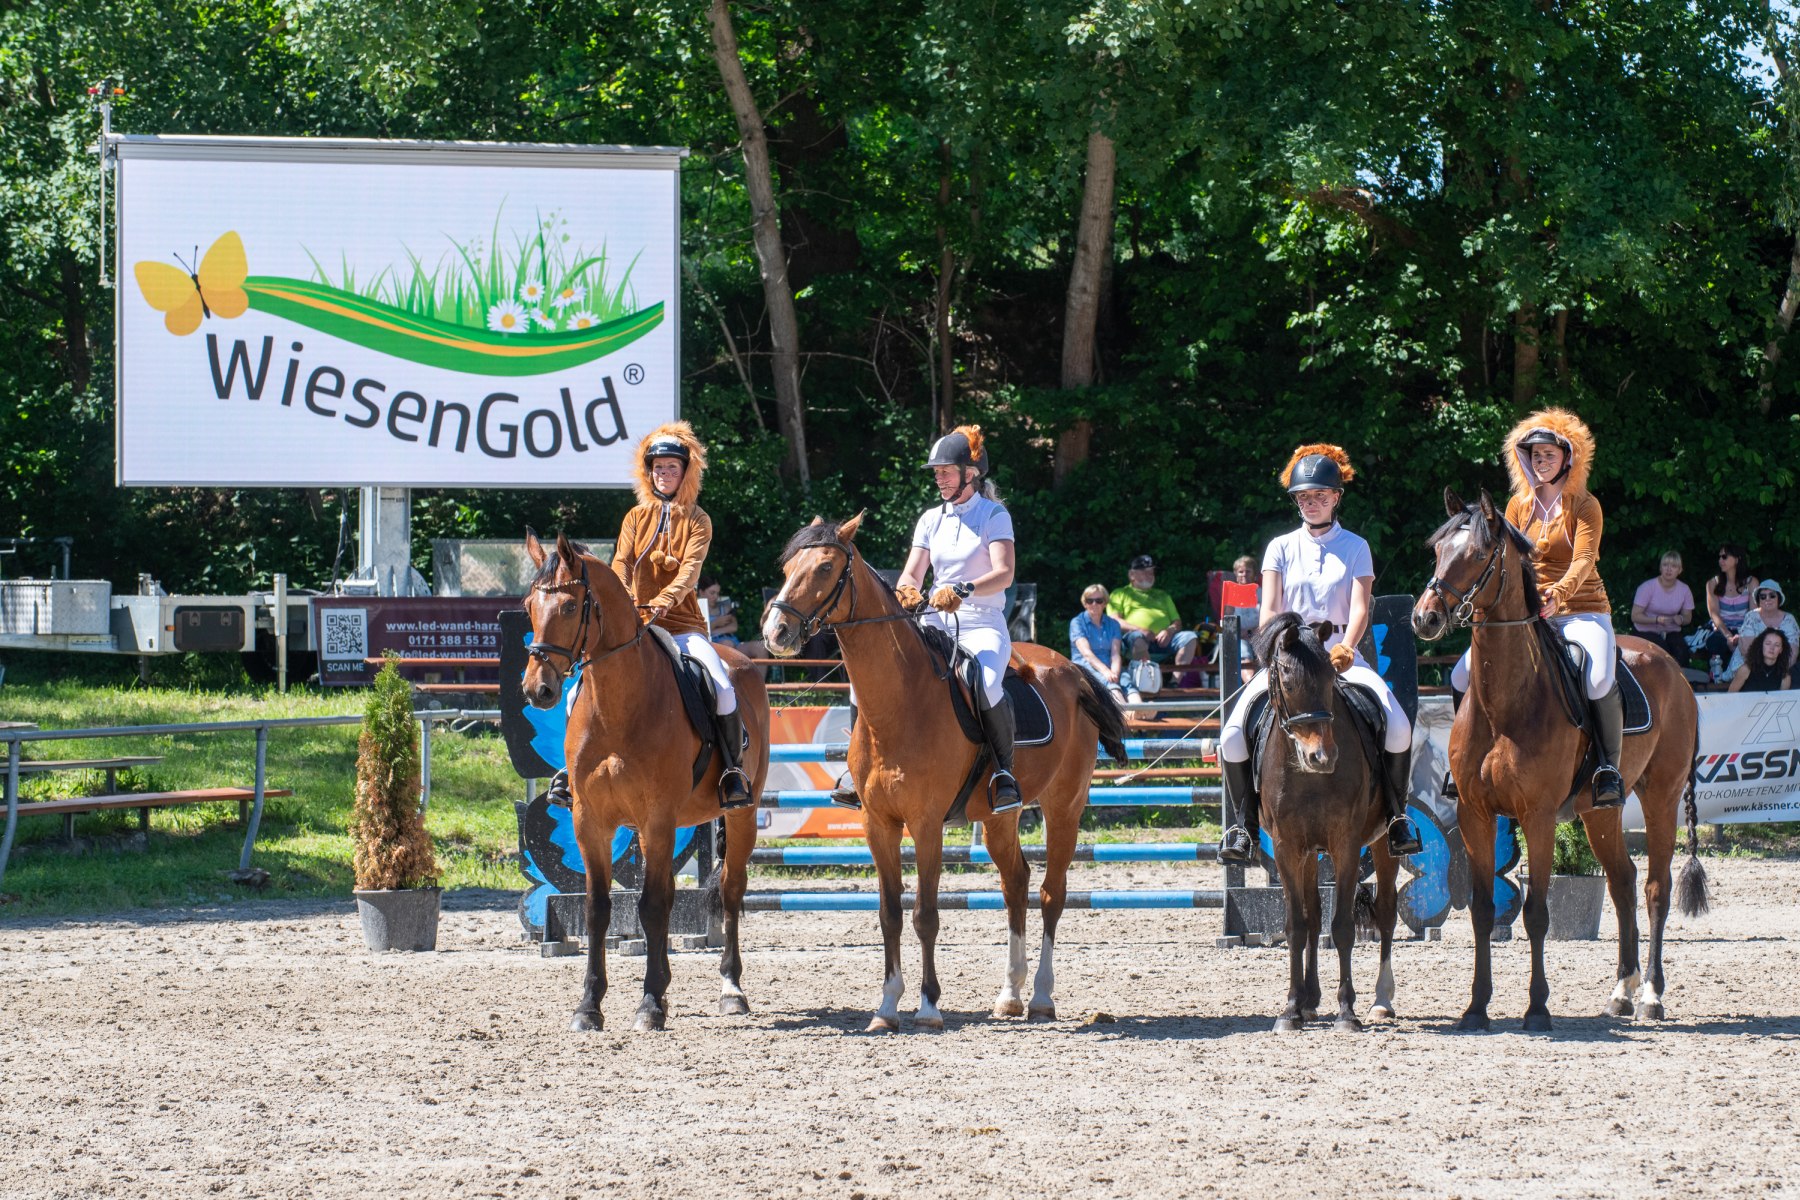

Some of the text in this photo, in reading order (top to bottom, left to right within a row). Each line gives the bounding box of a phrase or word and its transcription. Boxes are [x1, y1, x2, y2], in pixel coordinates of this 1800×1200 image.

[408, 635, 497, 646] 0171 388 55 23
[326, 662, 365, 672] SCAN ME
[1694, 784, 1784, 801] TO-KOMPETENZ
